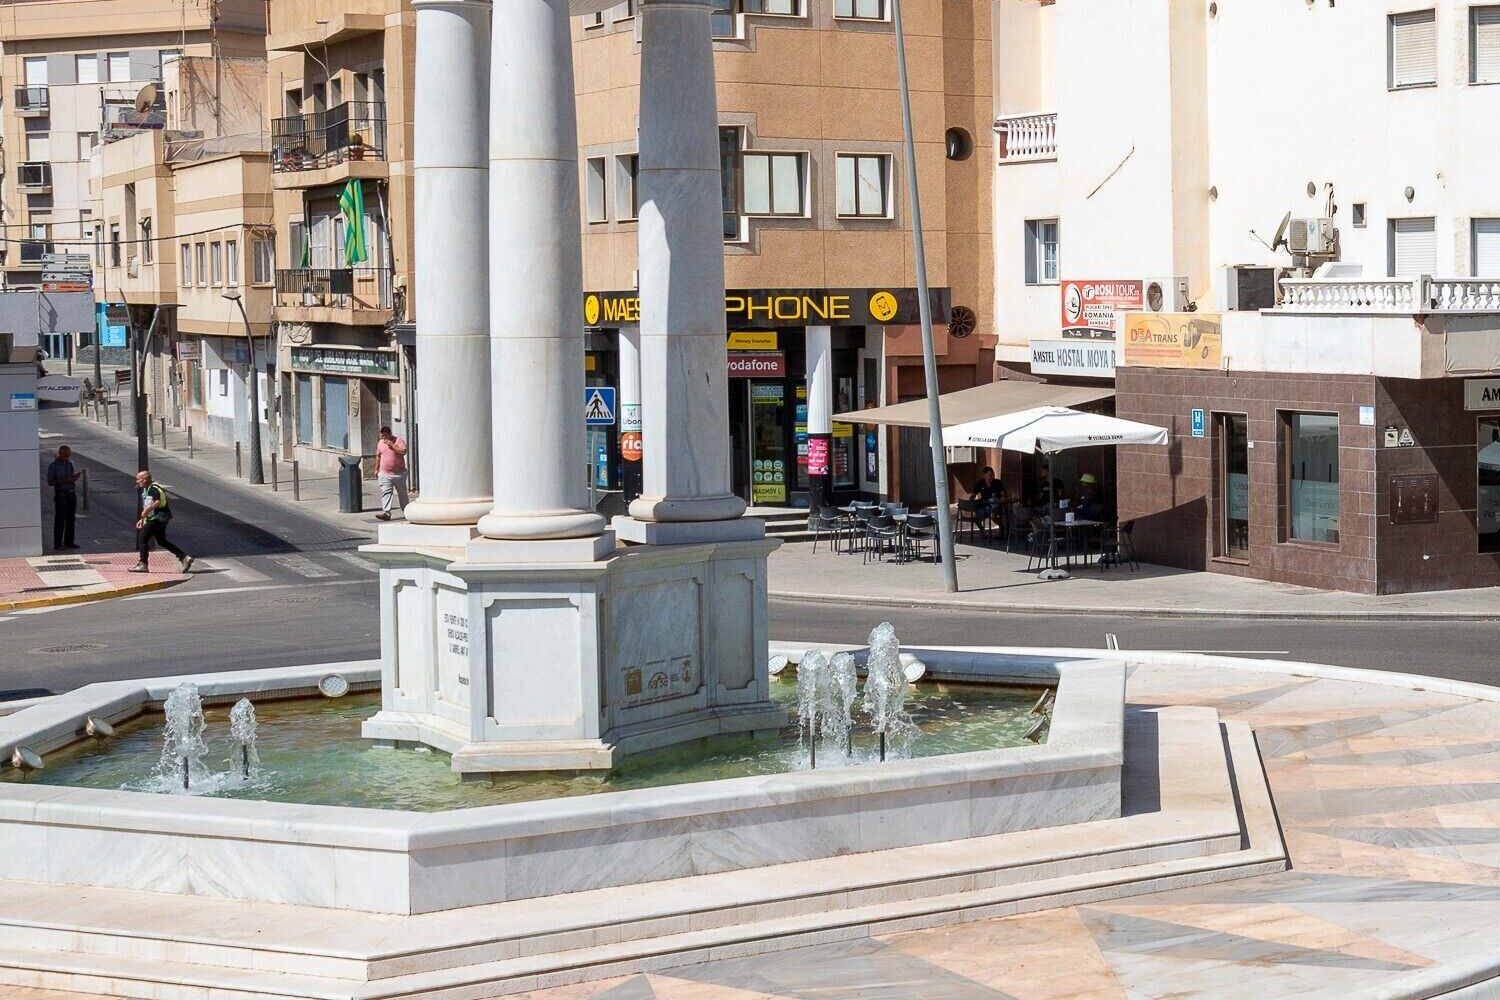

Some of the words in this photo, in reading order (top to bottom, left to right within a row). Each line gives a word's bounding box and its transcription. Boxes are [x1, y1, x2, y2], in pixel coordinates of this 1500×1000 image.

[725, 296, 850, 320] PHONE
[1153, 334, 1178, 343] TRANS
[727, 358, 779, 371] vodafone
[1033, 349, 1055, 363] AMSTEL
[1056, 348, 1085, 368] HOSTAL
[1087, 349, 1109, 369] MOYA
